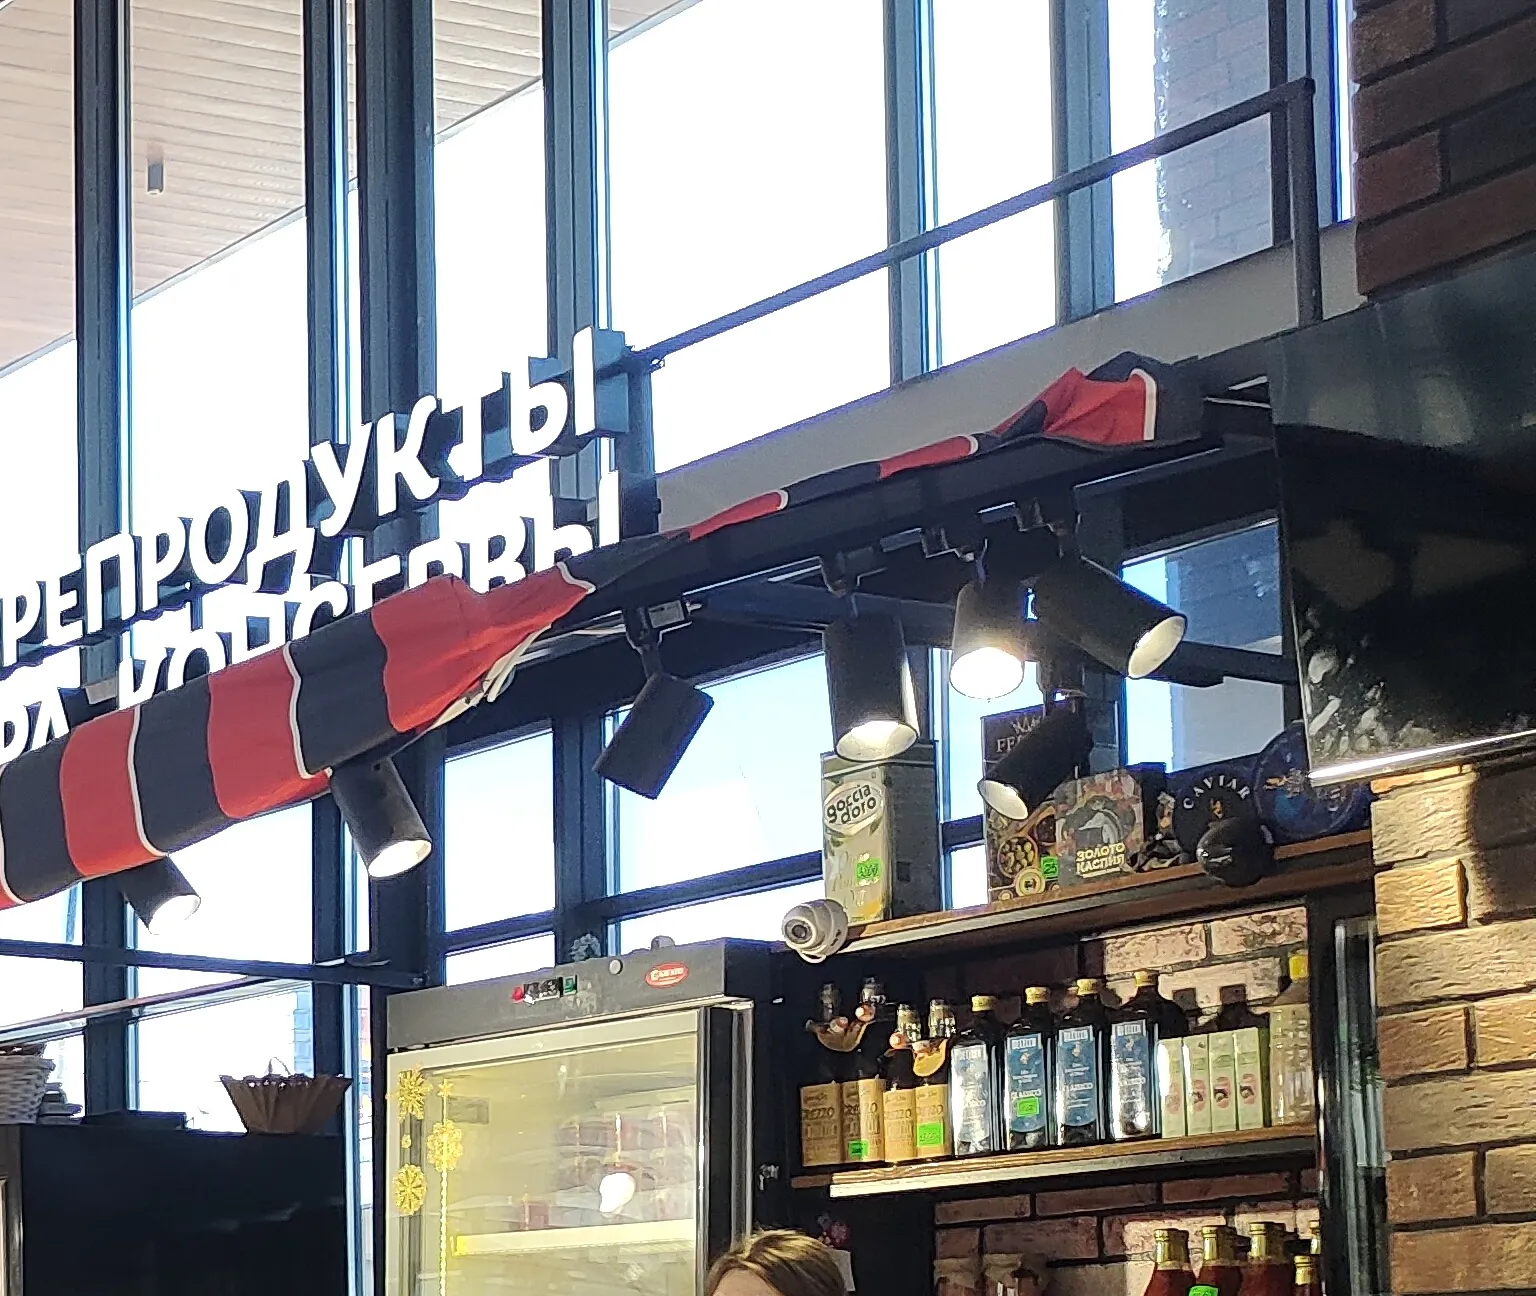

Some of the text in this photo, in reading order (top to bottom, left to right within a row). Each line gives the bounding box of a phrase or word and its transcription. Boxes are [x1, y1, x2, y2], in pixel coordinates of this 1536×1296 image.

[827, 784, 872, 824] goccia
[1183, 774, 1251, 809] CAVIAR
[1076, 843, 1126, 861] ЗОЛОТО
[1076, 855, 1126, 874] КАСПИЯ
